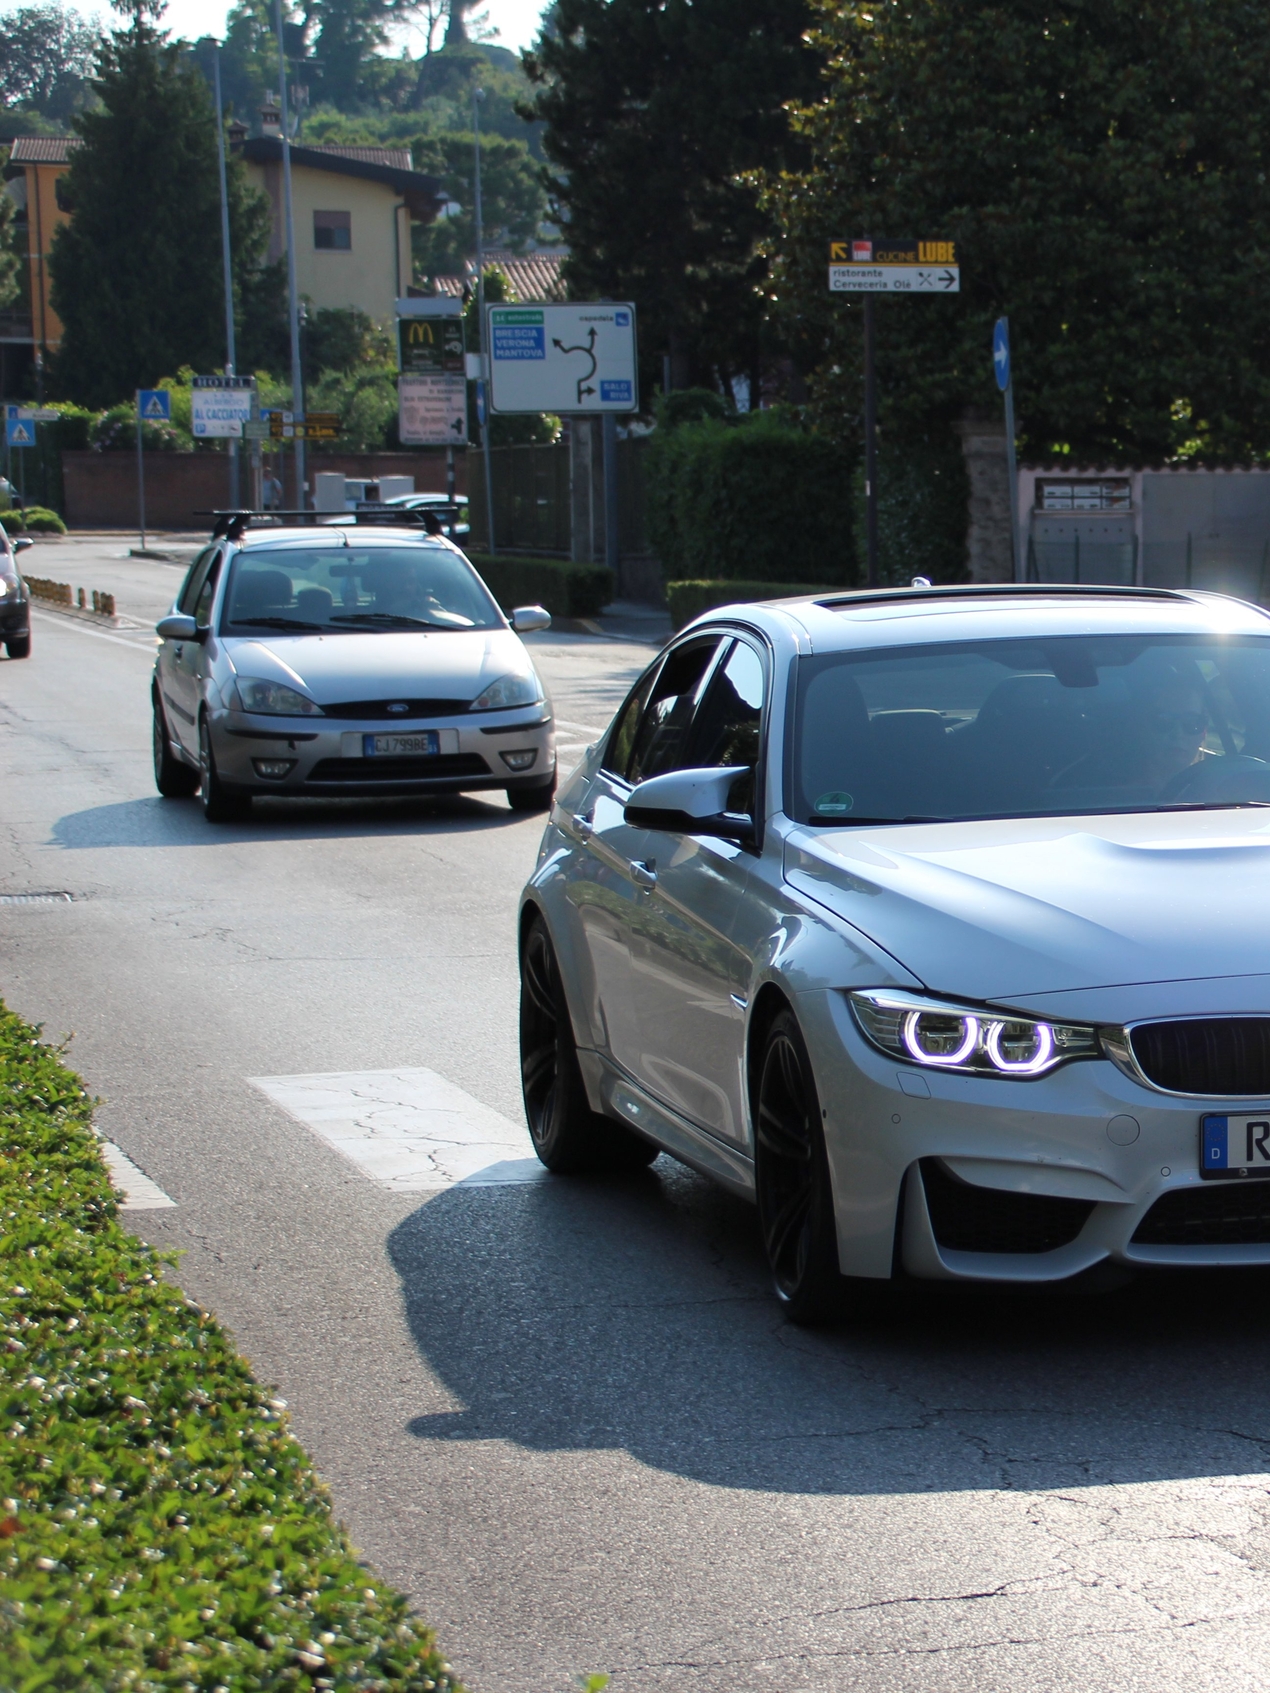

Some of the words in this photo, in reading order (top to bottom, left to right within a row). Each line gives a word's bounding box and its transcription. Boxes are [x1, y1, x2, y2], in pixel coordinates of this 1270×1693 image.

[875, 251, 917, 262] CUCINE
[917, 241, 956, 262] LUBE
[833, 269, 884, 278] ristorante
[495, 328, 538, 338] BRESCIA
[496, 338, 536, 348] VERONA
[496, 348, 544, 358] MANTOVA
[197, 378, 244, 388] HOTEL
[609, 391, 630, 400] RIVA
[194, 408, 204, 420] AL
[375, 738, 390, 753] CJ
[1210, 1148, 1221, 1160] D
